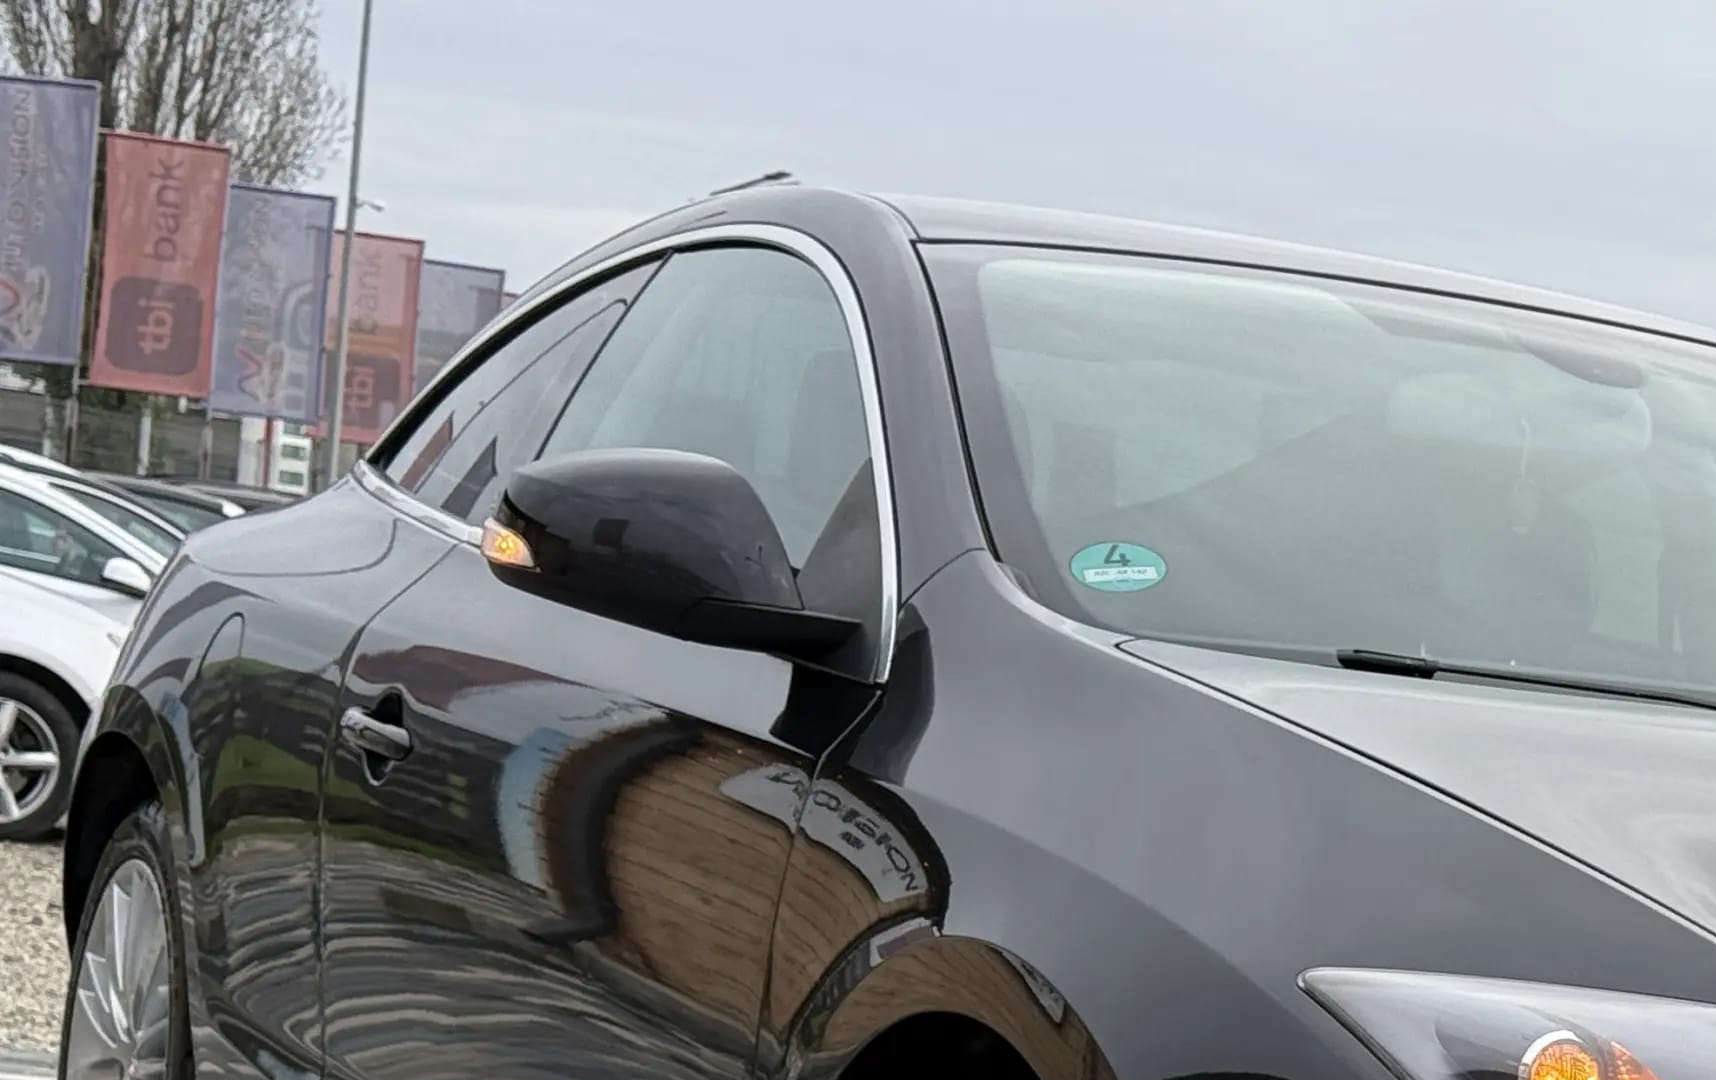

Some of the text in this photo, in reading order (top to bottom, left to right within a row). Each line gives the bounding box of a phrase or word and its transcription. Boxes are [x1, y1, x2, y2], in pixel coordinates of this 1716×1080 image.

[144, 157, 184, 263] bank
[137, 296, 175, 355] tbi
[1103, 543, 1131, 567] 4
